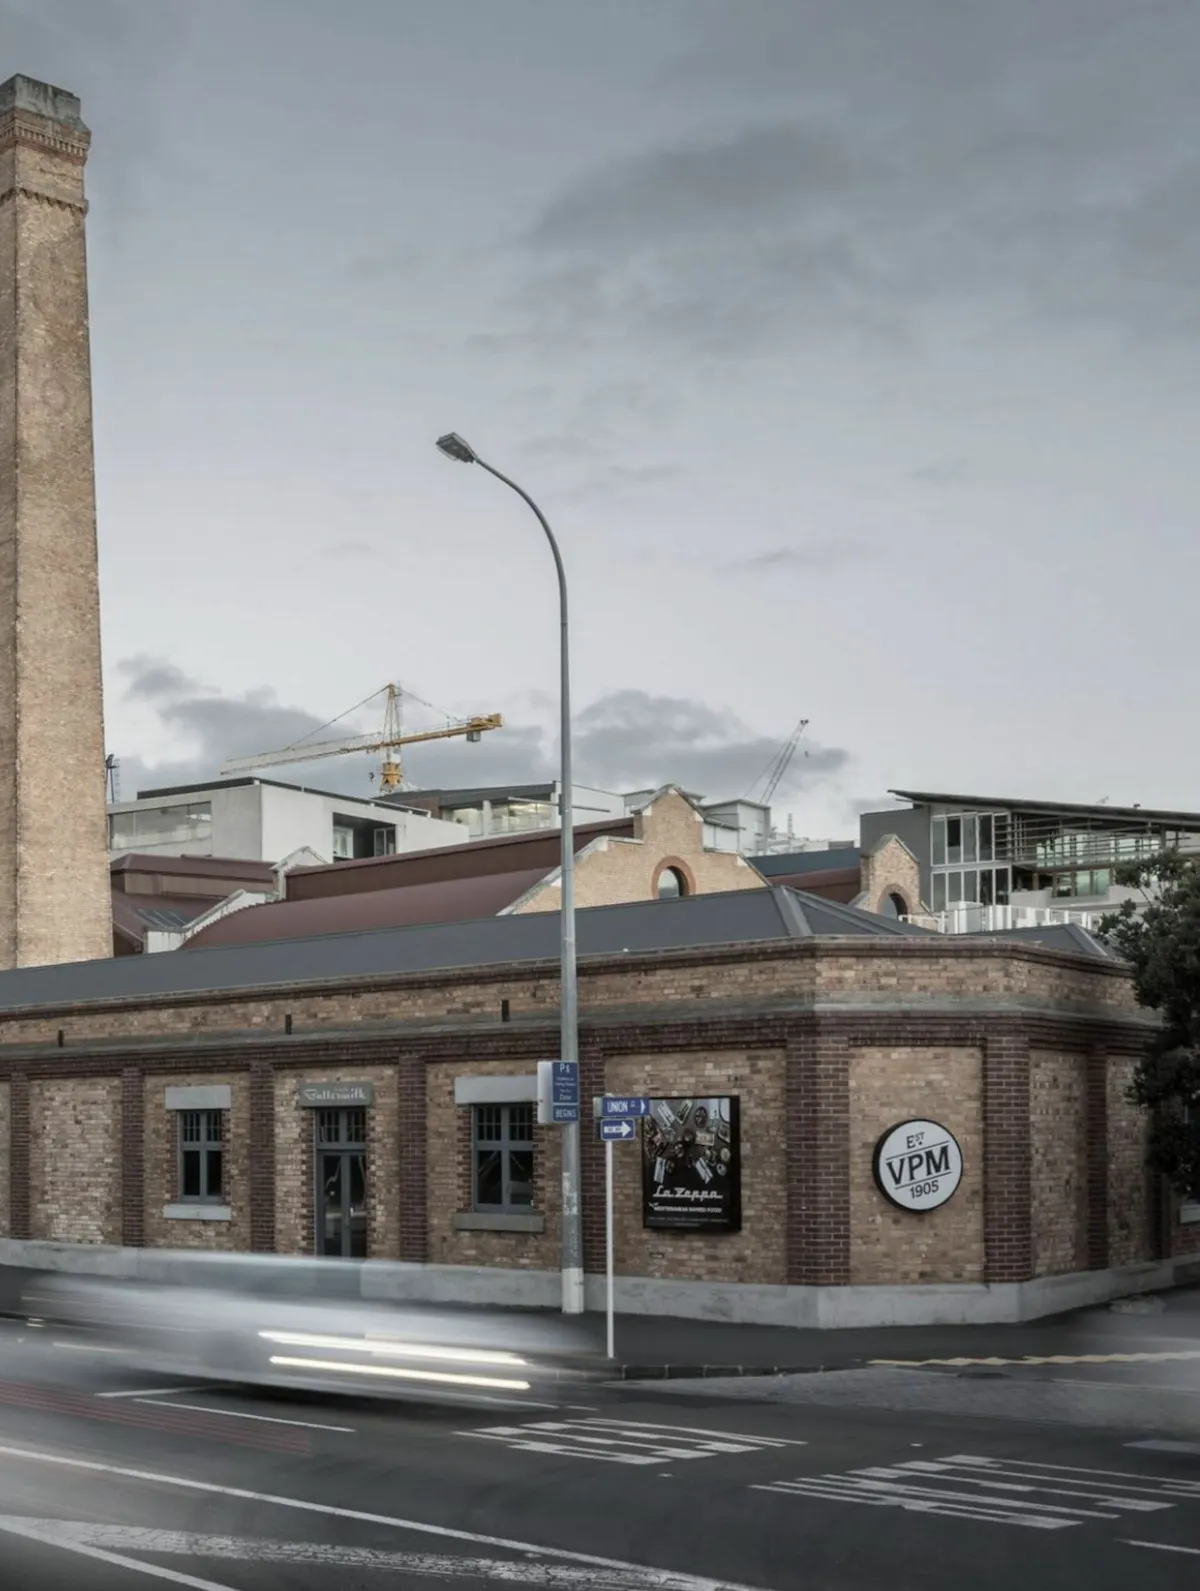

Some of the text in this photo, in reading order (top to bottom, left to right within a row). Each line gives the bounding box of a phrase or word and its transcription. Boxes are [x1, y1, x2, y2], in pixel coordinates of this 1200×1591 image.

[555, 1108, 577, 1118] BEGINS
[606, 1100, 628, 1113] UNION
[886, 1145, 952, 1186] VPM
[652, 1185, 723, 1202] La Zeppa
[909, 1179, 940, 1199] 1905
